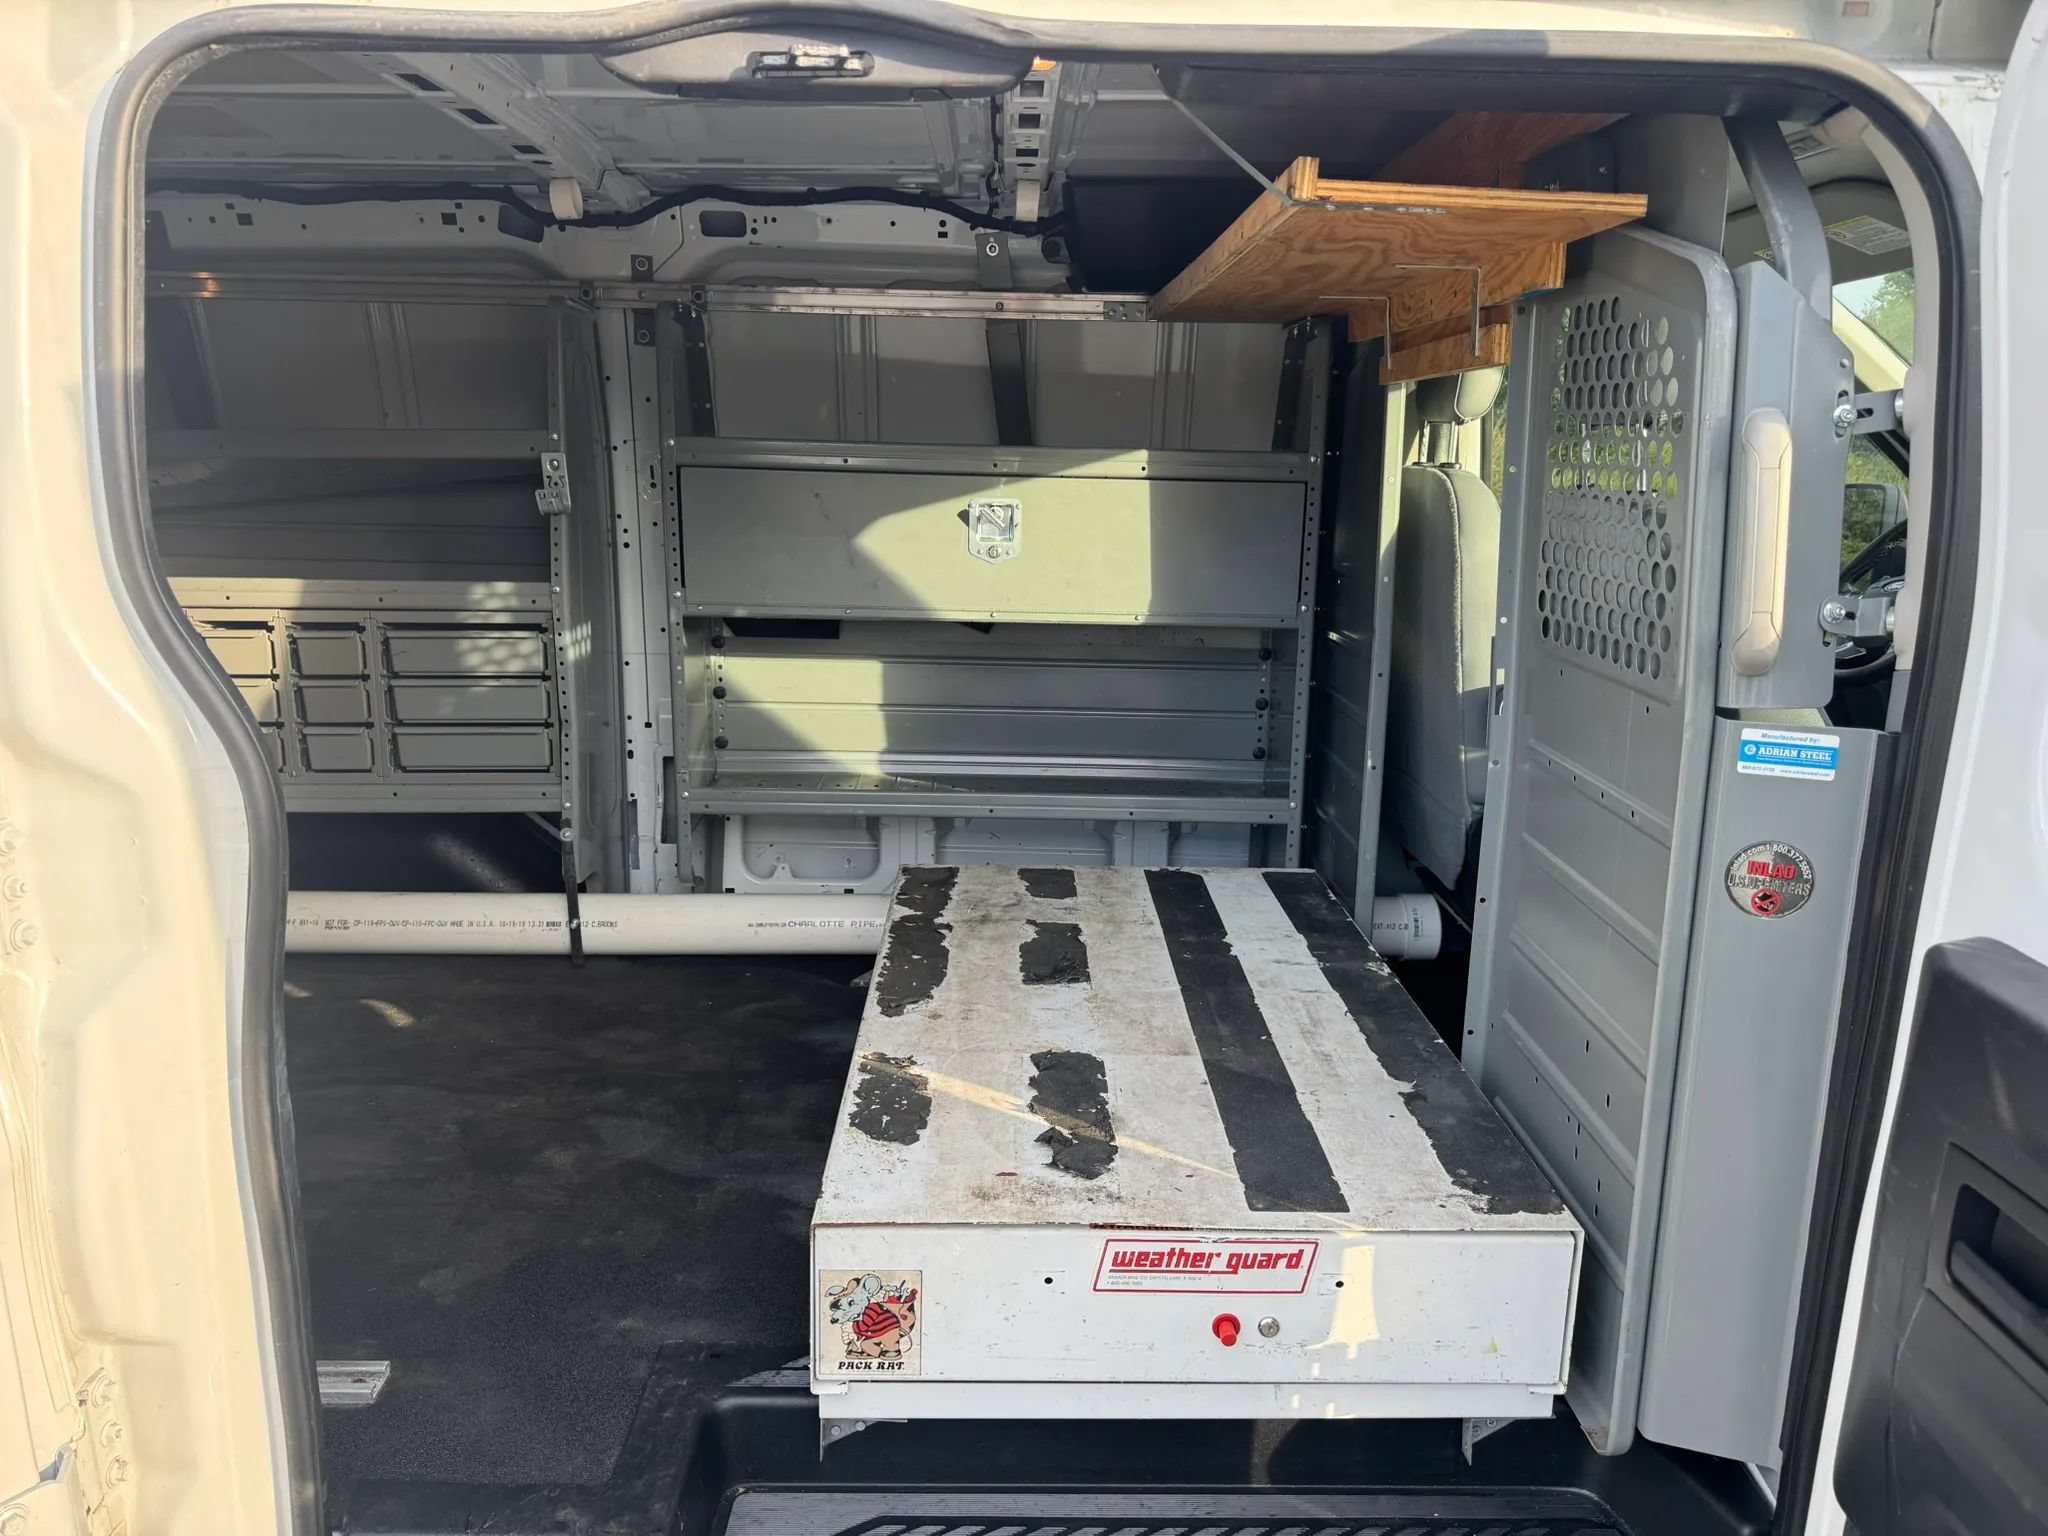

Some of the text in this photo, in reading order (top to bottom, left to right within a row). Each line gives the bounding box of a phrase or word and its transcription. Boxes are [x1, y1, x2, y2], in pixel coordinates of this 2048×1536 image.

[1761, 732, 1808, 743] Manufactured
[1758, 746, 1832, 761] ADRIAN STEEL
[1730, 844, 1765, 871] inlad.com
[1747, 860, 1796, 880] INLAD
[787, 920, 845, 928] CHARLOTTE
[1111, 1247, 1305, 1275] weather guard
[837, 1361, 873, 1370] PACK
